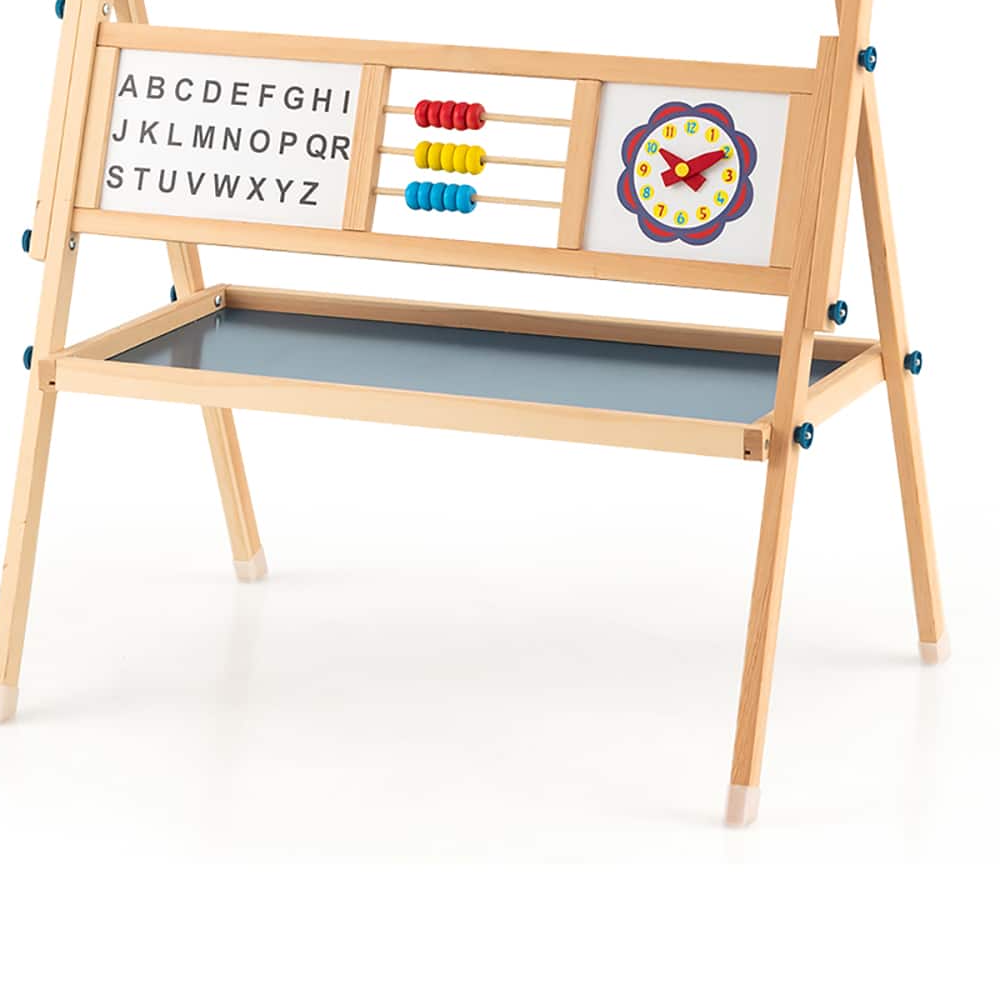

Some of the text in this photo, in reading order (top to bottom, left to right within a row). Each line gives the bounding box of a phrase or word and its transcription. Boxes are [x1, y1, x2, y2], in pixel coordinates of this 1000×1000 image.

[118, 74, 351, 114] A B C D E F G H I
[665, 126, 675, 139] 11
[686, 121, 697, 134] 12
[112, 119, 350, 161] J K L M N O P Q R
[709, 128, 716, 142] 1
[646, 141, 658, 154] 10
[639, 163, 648, 177] 9
[724, 169, 733, 183] 3
[106, 165, 319, 206] S T U V W X Y Z
[642, 186, 651, 199] 8
[657, 204, 666, 217] 7
[699, 207, 707, 220] 5
[676, 211, 686, 225] 6
